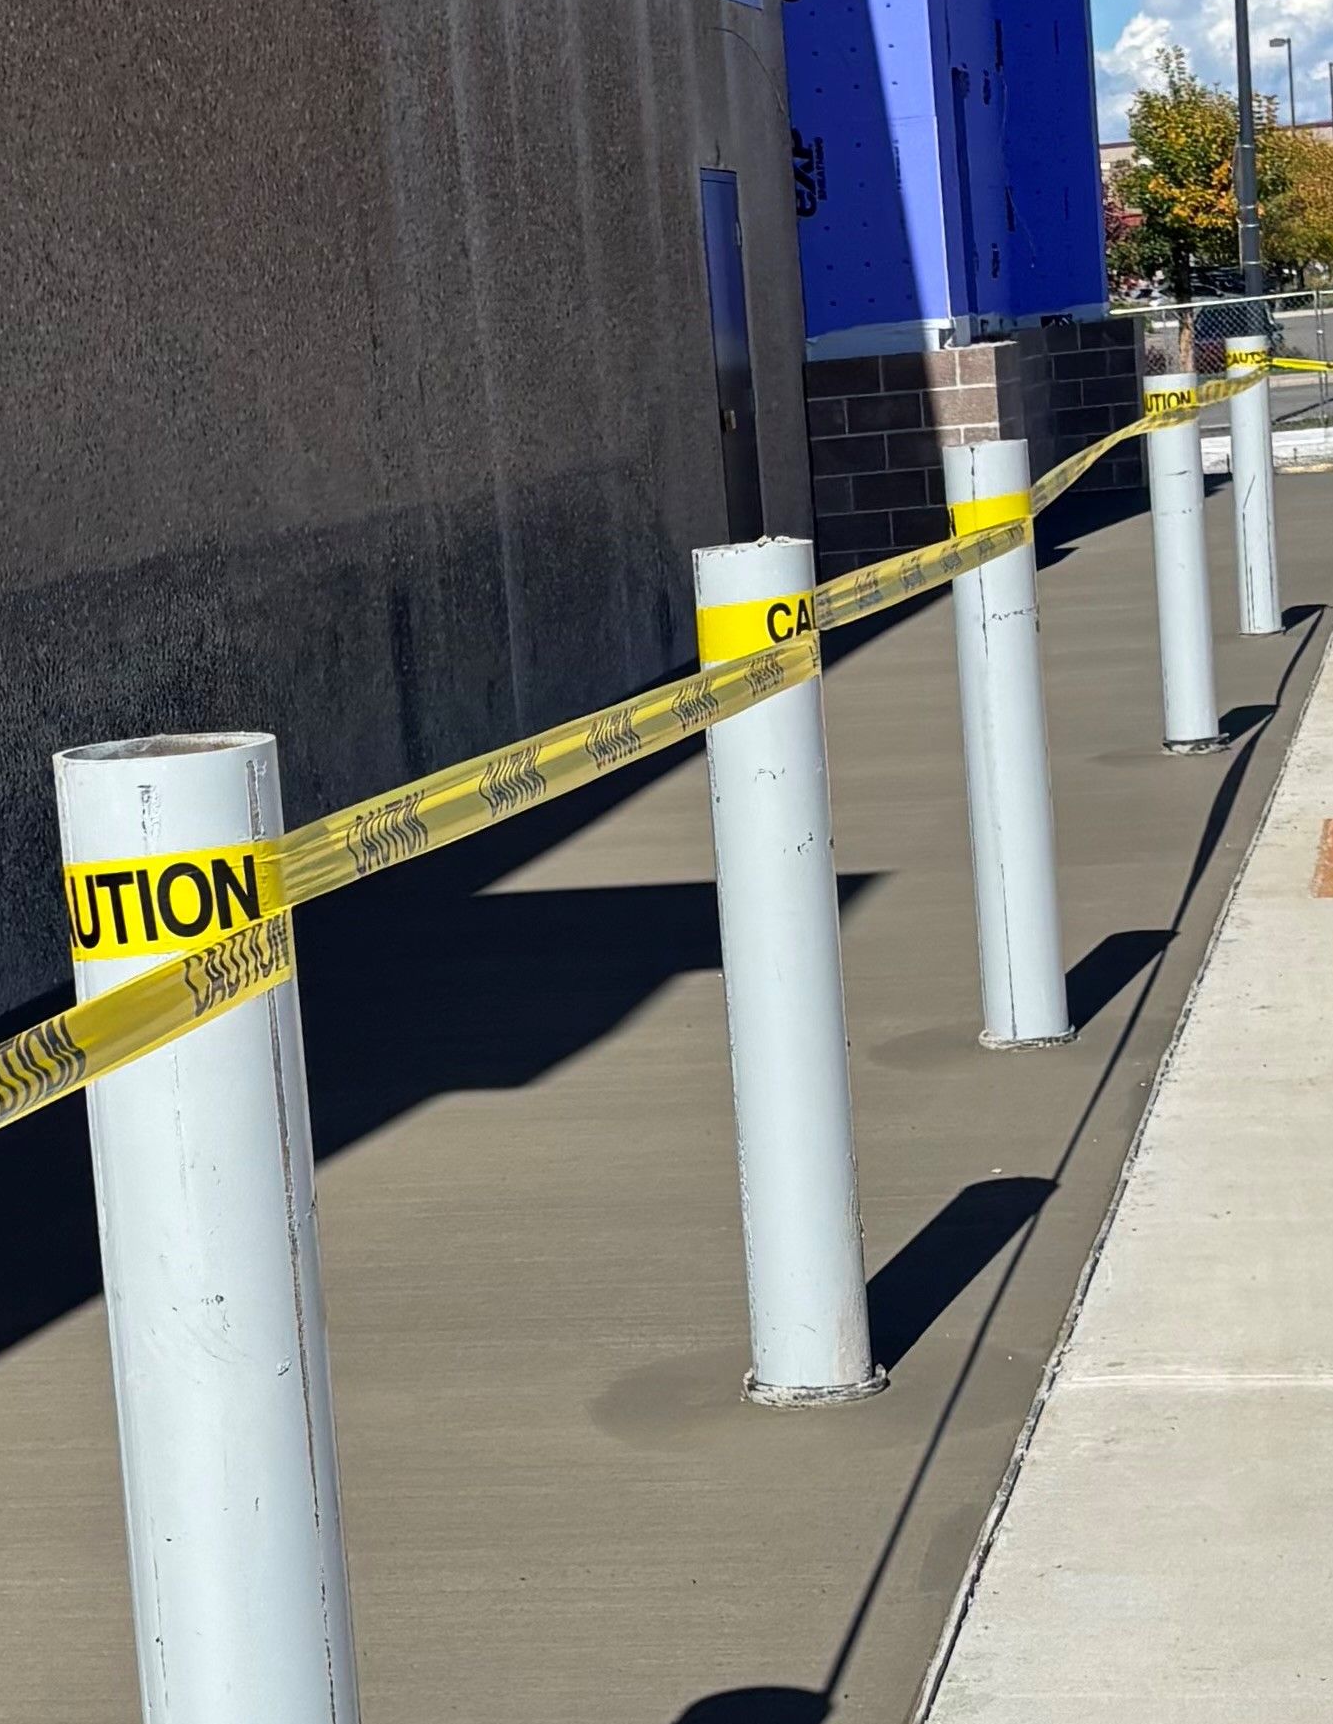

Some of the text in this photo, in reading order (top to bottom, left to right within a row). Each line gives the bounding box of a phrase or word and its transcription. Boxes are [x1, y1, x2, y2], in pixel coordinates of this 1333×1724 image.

[1144, 390, 1191, 413] UTION
[766, 596, 815, 644] CA
[347, 789, 429, 875] CAUTION
[68, 854, 262, 949] UTION
